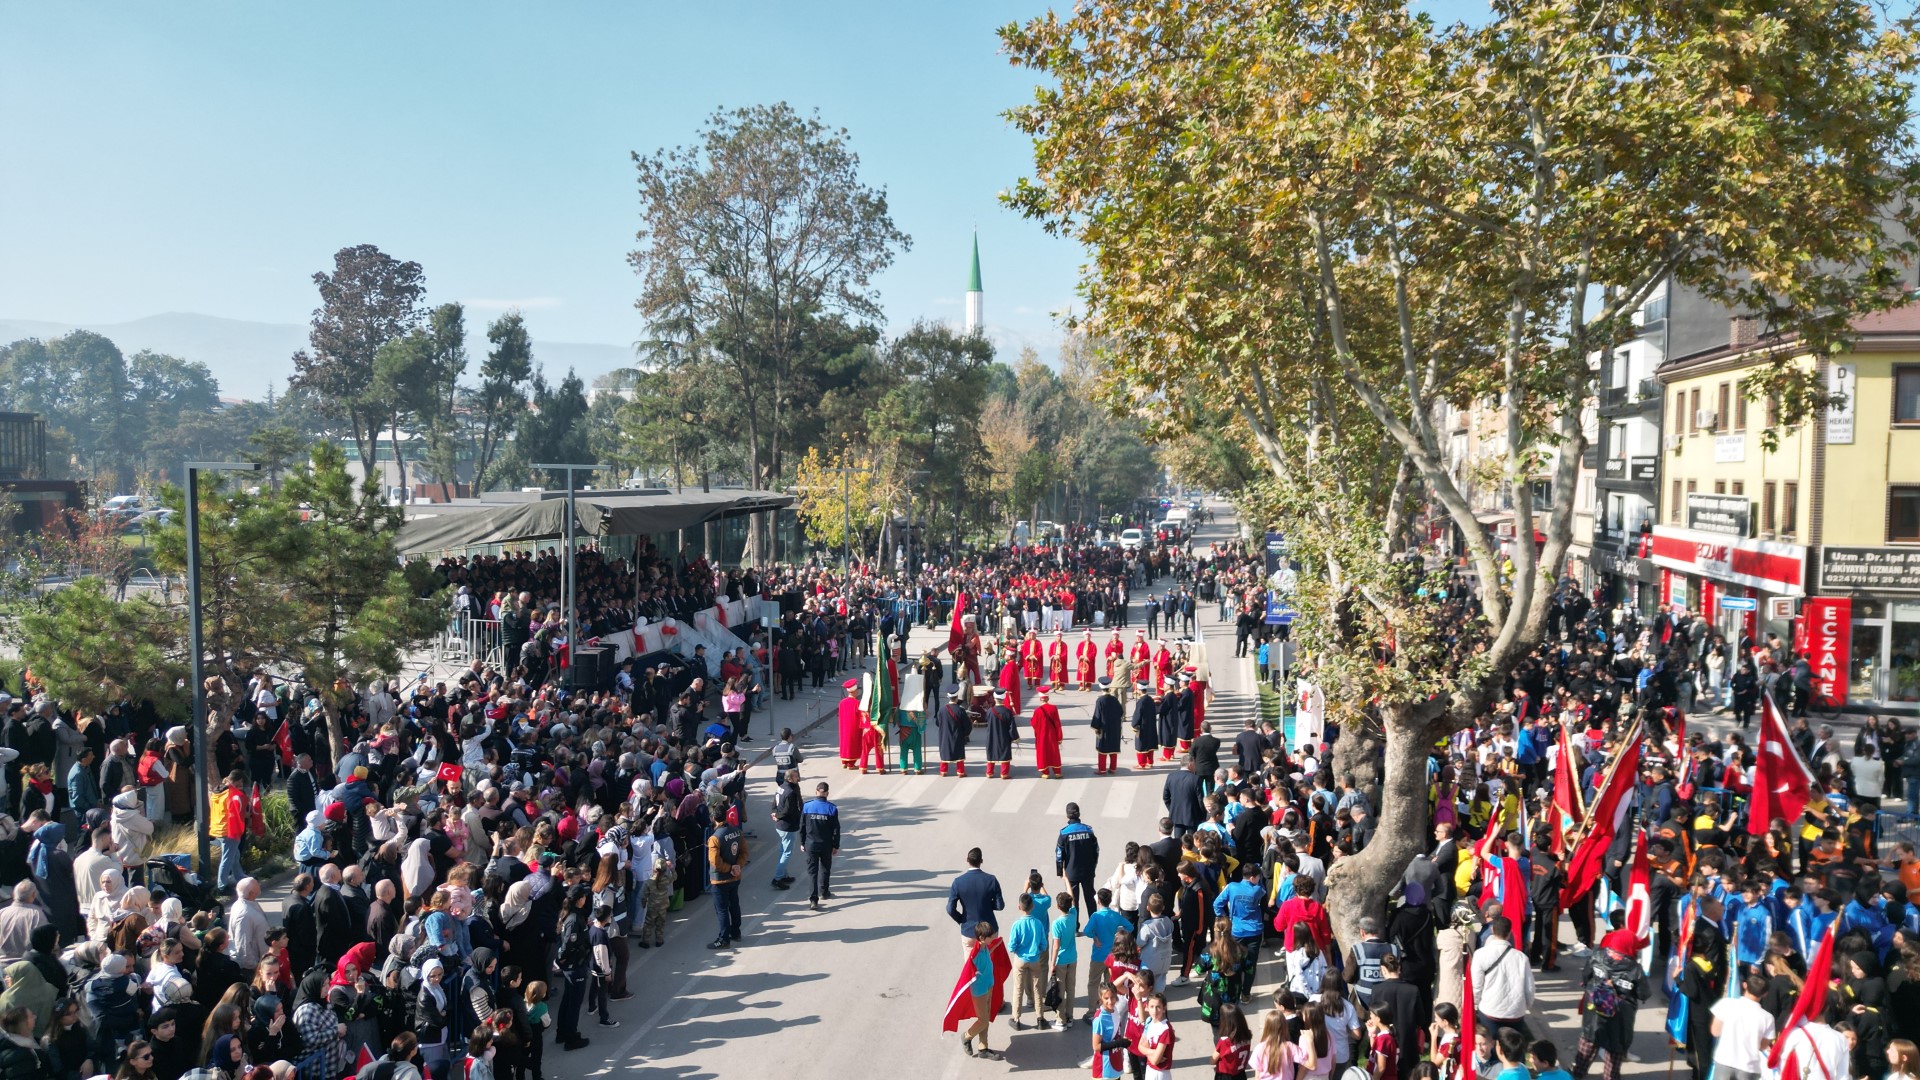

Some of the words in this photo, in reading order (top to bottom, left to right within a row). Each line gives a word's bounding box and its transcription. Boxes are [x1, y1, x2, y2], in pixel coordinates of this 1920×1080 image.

[1870, 565, 1903, 574] UZMANI
[1776, 602, 1789, 616] E
[1820, 606, 1838, 697] ECZANE
[1068, 832, 1090, 841] ZABITA
